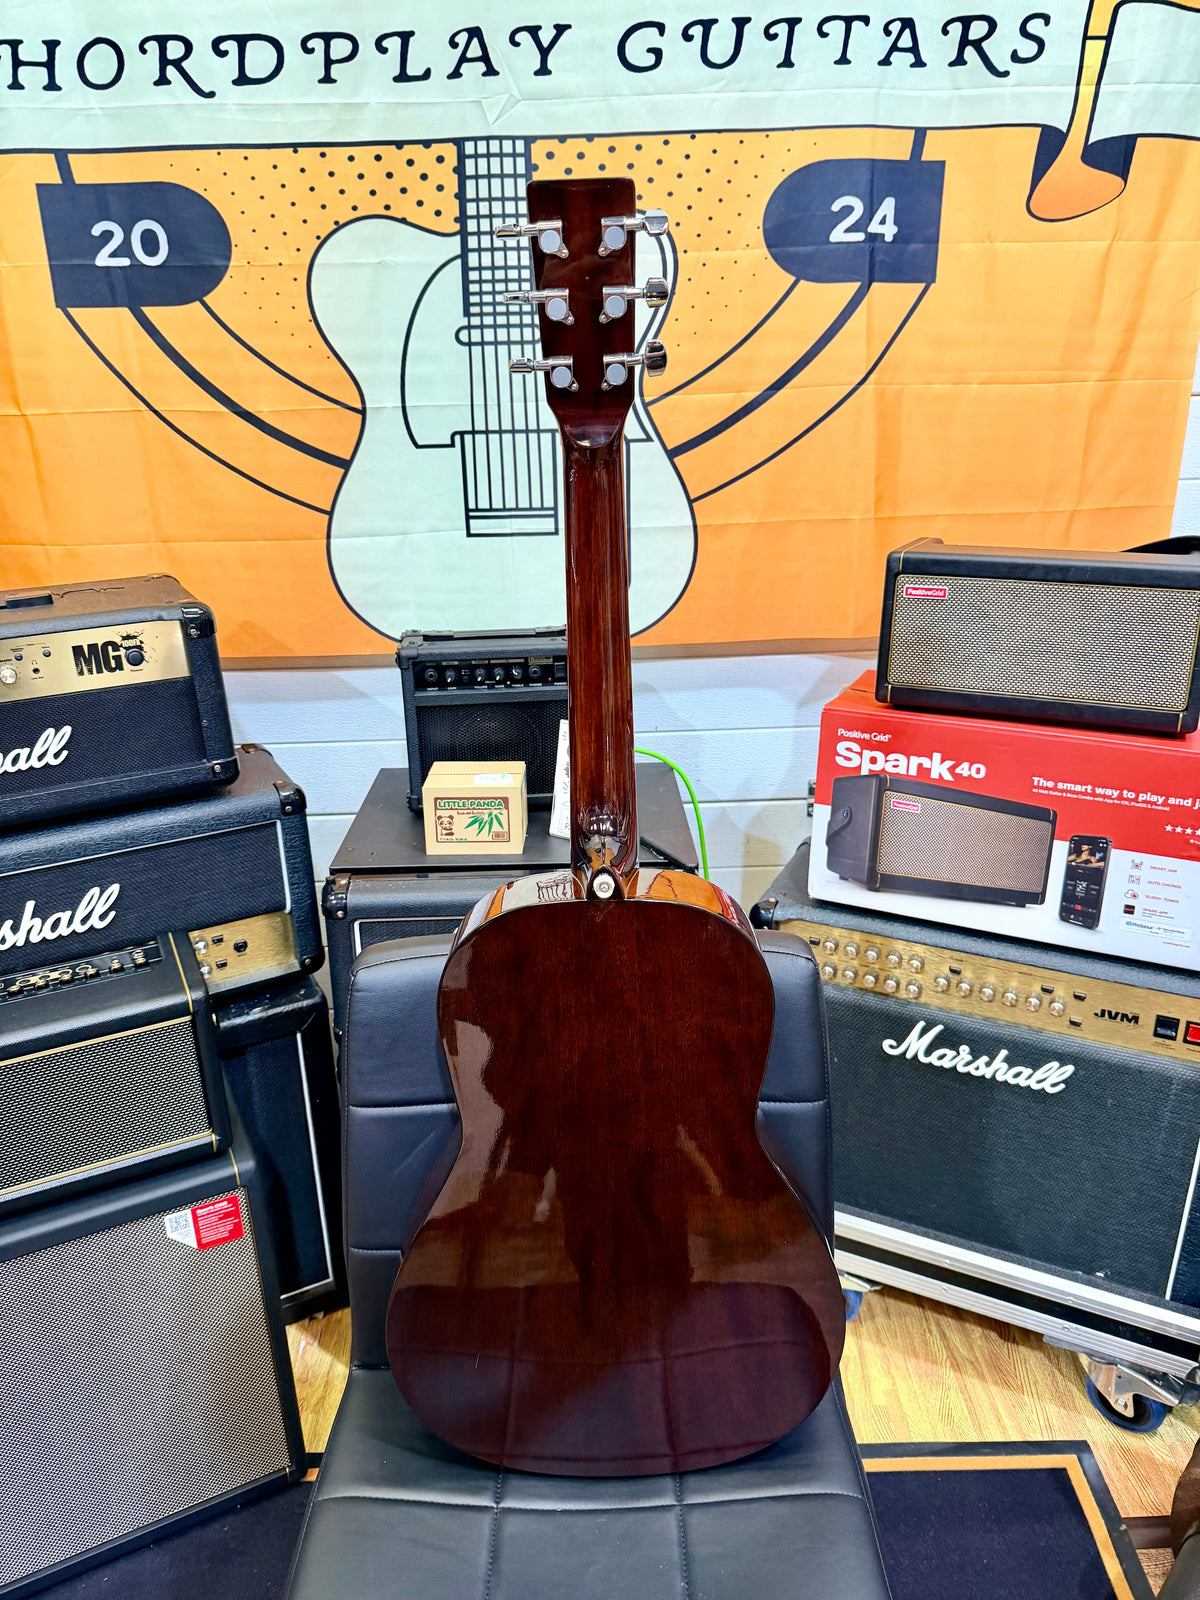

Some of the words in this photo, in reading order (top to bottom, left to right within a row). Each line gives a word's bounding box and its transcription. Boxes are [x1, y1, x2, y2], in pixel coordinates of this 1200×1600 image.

[617, 14, 1051, 78] GUITARS
[828, 195, 898, 243] 24
[91, 219, 169, 267] 20
[907, 588, 945, 597] PositiveGrid
[72, 640, 124, 677] MG
[838, 728, 870, 740] Positive
[835, 741, 955, 781] Spark
[955, 762, 986, 779] 40
[437, 800, 467, 808] LITTLE
[469, 800, 504, 808] PANDA
[1032, 777, 1054, 788] The
[1057, 782, 1092, 793] smart
[1095, 786, 1121, 799] way
[1122, 789, 1136, 799] to
[1138, 792, 1165, 805] play
[1168, 795, 1193, 807] and
[1094, 1008, 1140, 1025] JVM
[882, 1020, 1075, 1094] Marshall
